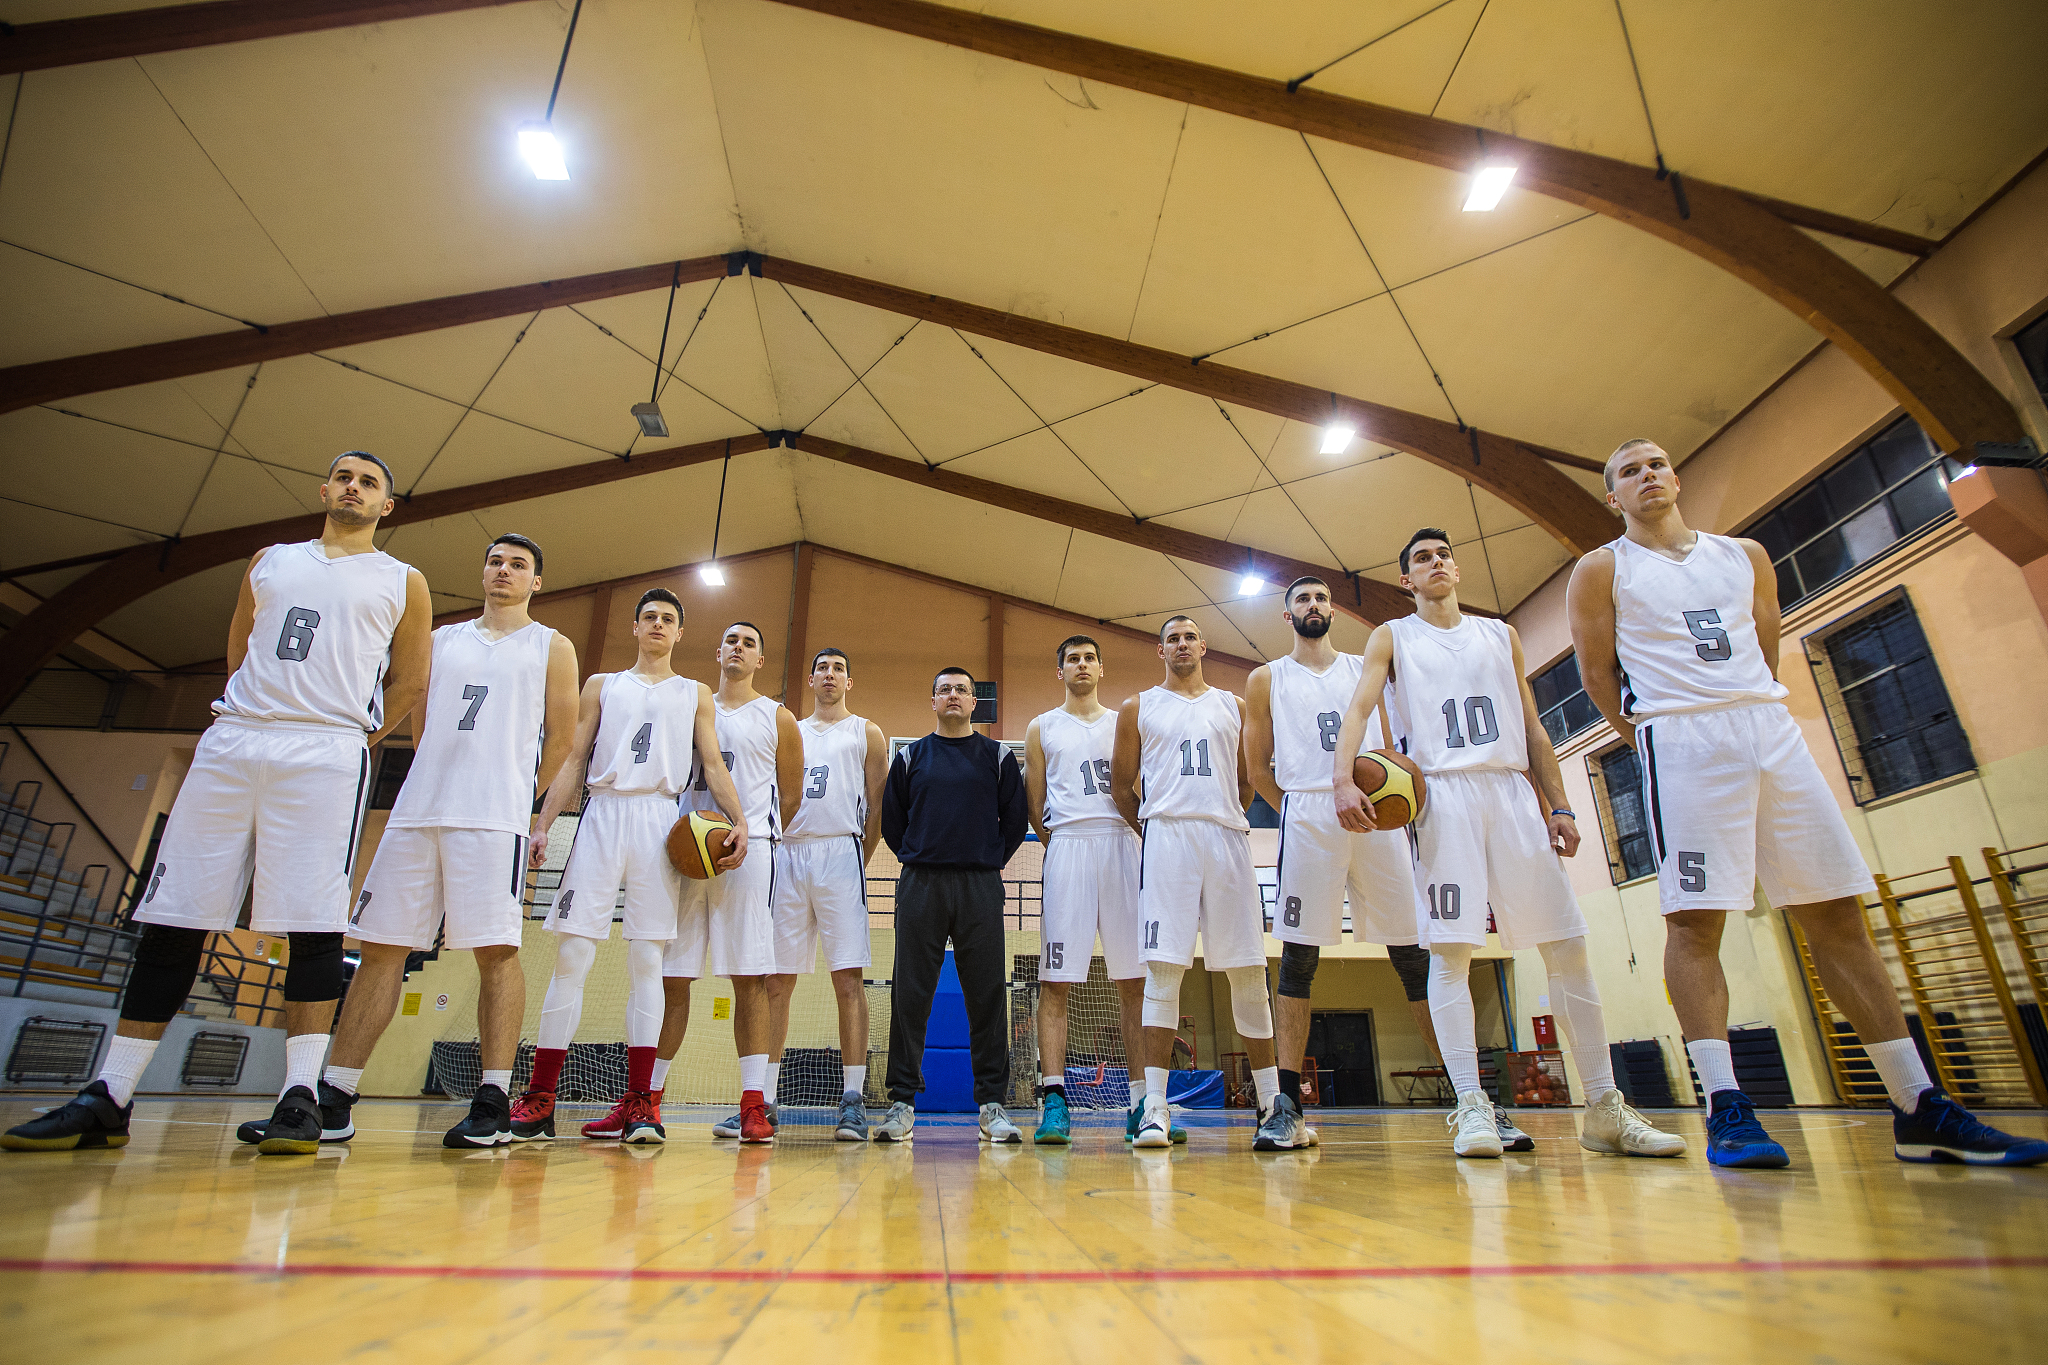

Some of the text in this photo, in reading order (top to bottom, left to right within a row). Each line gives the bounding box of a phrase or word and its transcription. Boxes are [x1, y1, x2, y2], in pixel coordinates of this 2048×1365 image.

[276, 606, 321, 662] 6
[1682, 609, 1732, 662] 5
[458, 684, 488, 730] 7
[1442, 696, 1499, 748] 10
[631, 723, 652, 764] 4
[1317, 710, 1342, 752] 8
[1180, 739, 1211, 776] 11
[802, 765, 830, 799] 3
[1080, 758, 1112, 796] 15
[1678, 851, 1706, 892] 5
[350, 889, 373, 926] 7
[557, 889, 575, 919] 4
[1283, 896, 1302, 928] 8
[1428, 884, 1460, 919] 10
[1144, 920, 1160, 950] 11
[1045, 942, 1064, 969] 15
